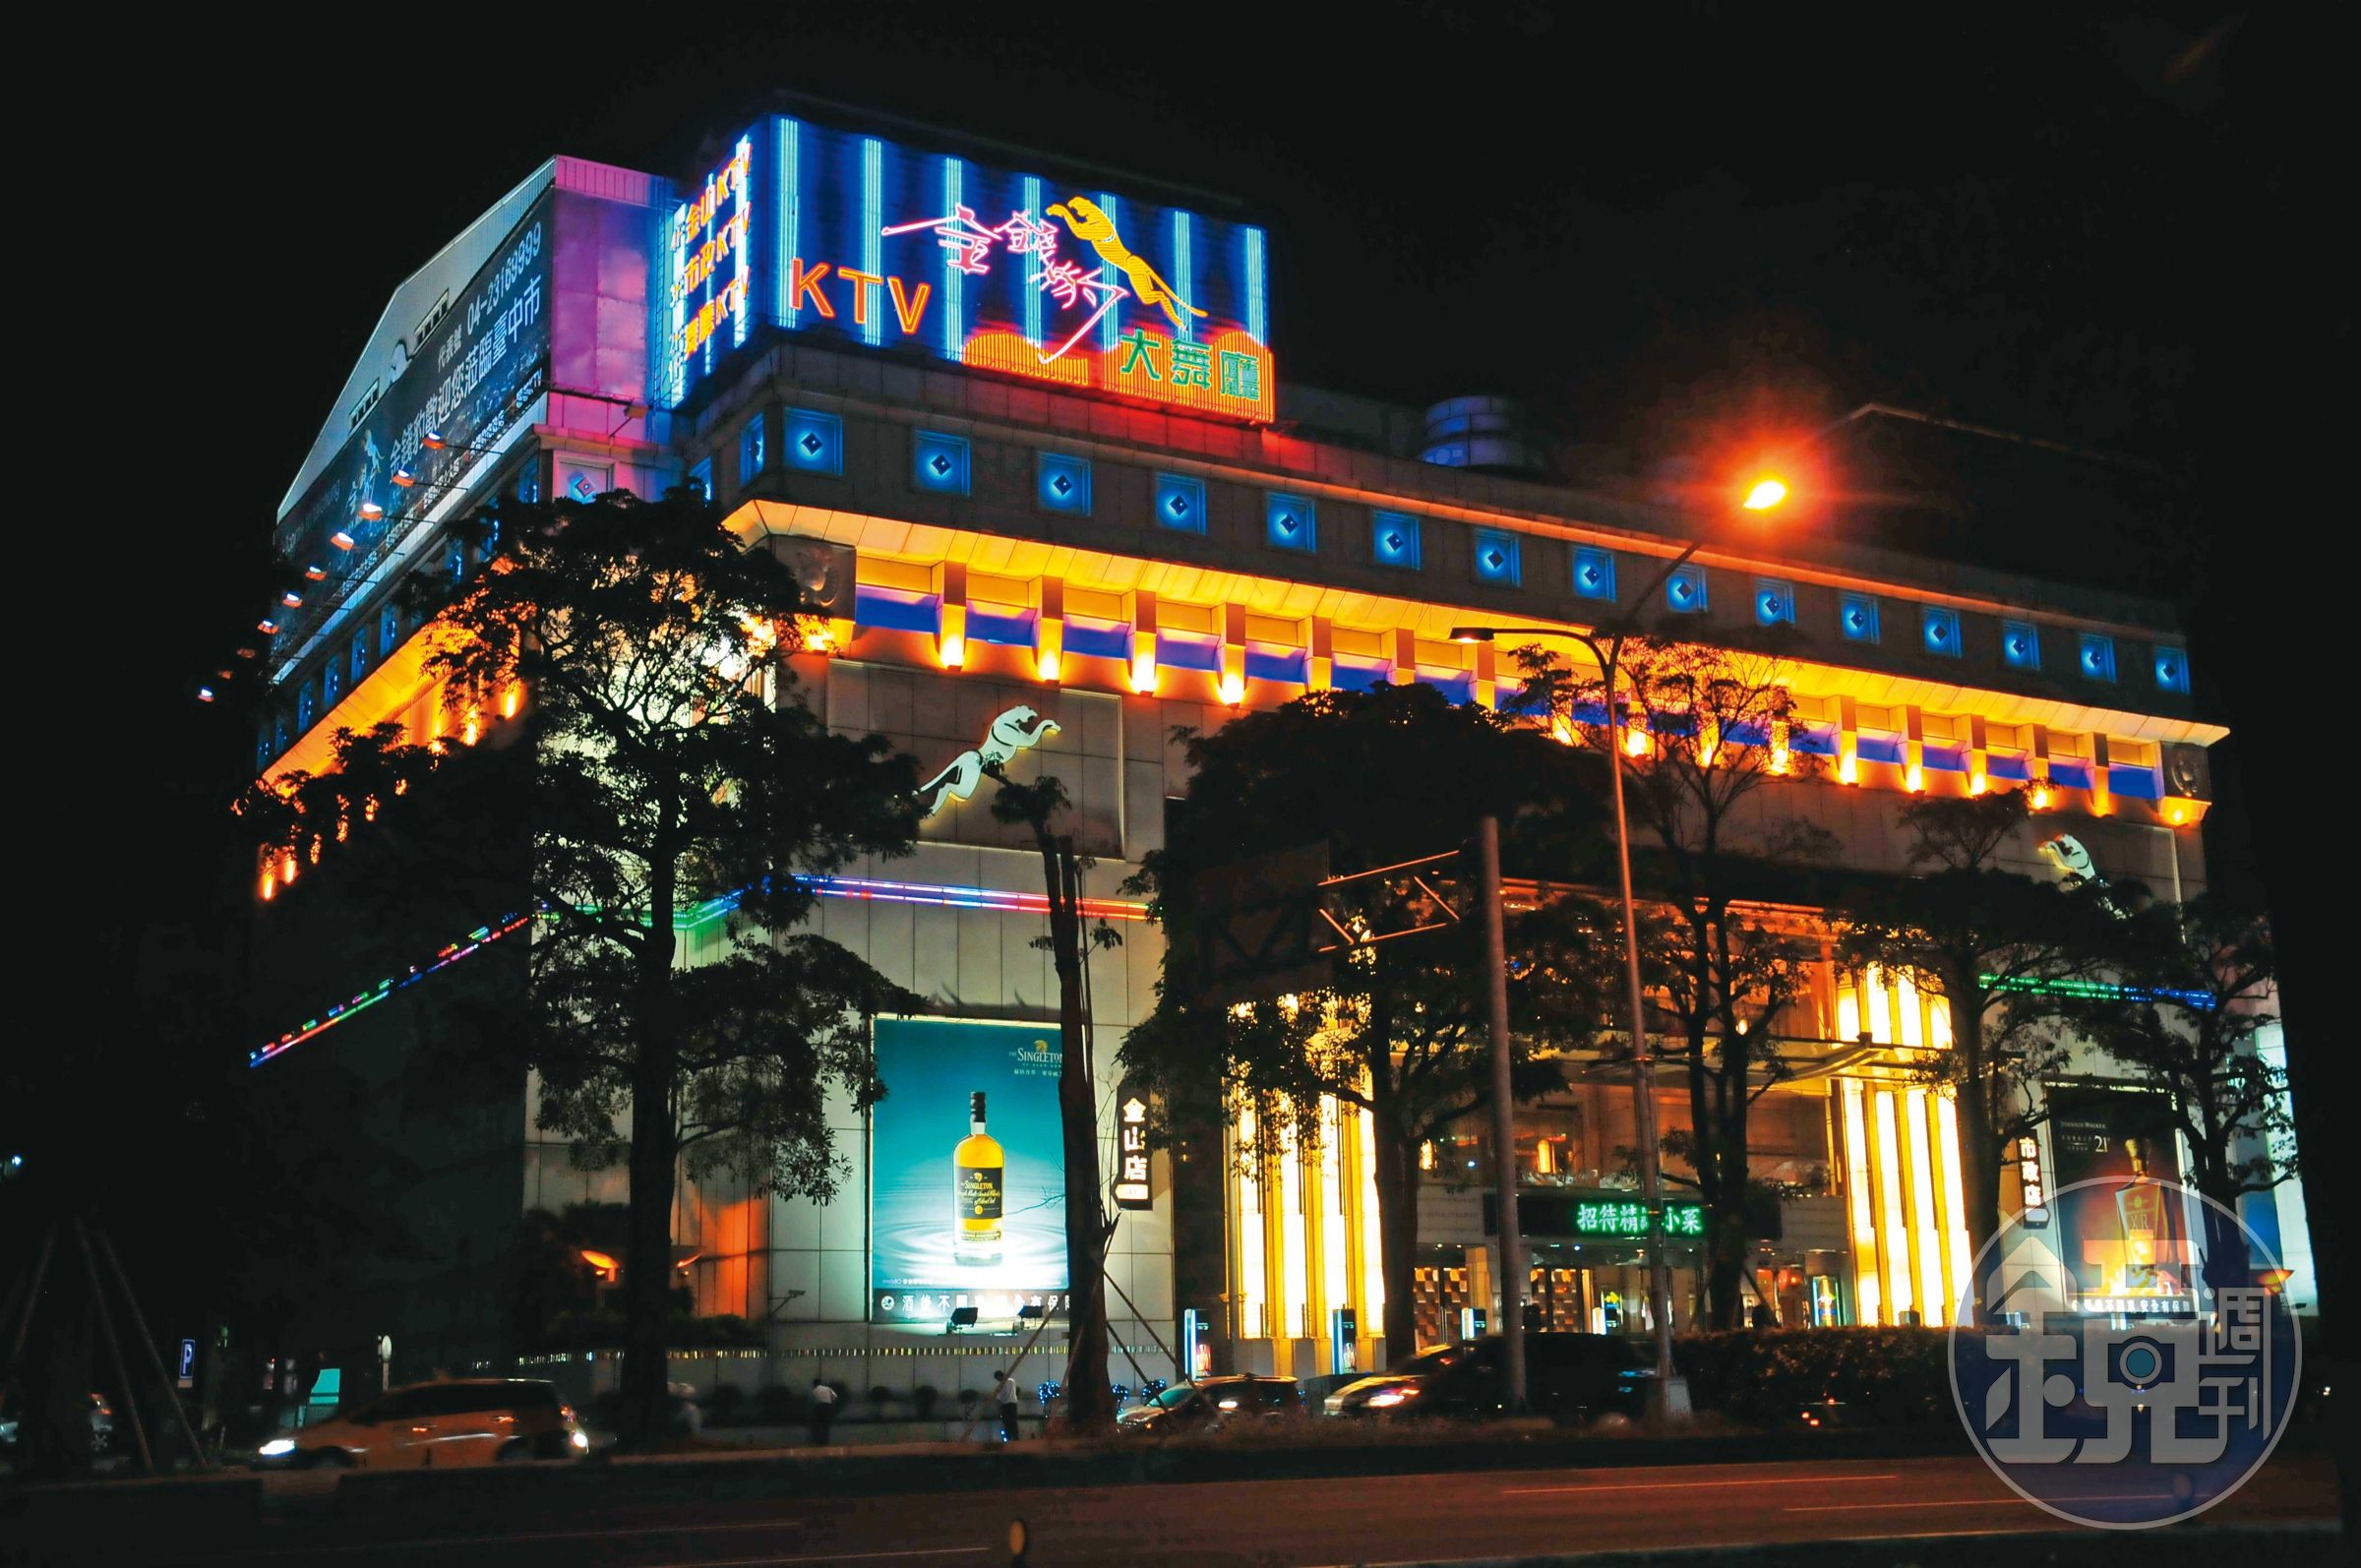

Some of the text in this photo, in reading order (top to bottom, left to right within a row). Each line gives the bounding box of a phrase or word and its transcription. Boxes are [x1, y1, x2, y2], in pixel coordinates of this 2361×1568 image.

[467, 221, 541, 335] 04-23169999
[789, 257, 933, 335] KTV
[1120, 328, 1260, 401] 大舞廳
[1122, 1097, 1148, 1180] 金山店
[2019, 1136, 2042, 1207] 市政店
[2094, 1134, 2108, 1153] 21
[182, 1344, 193, 1374] P
